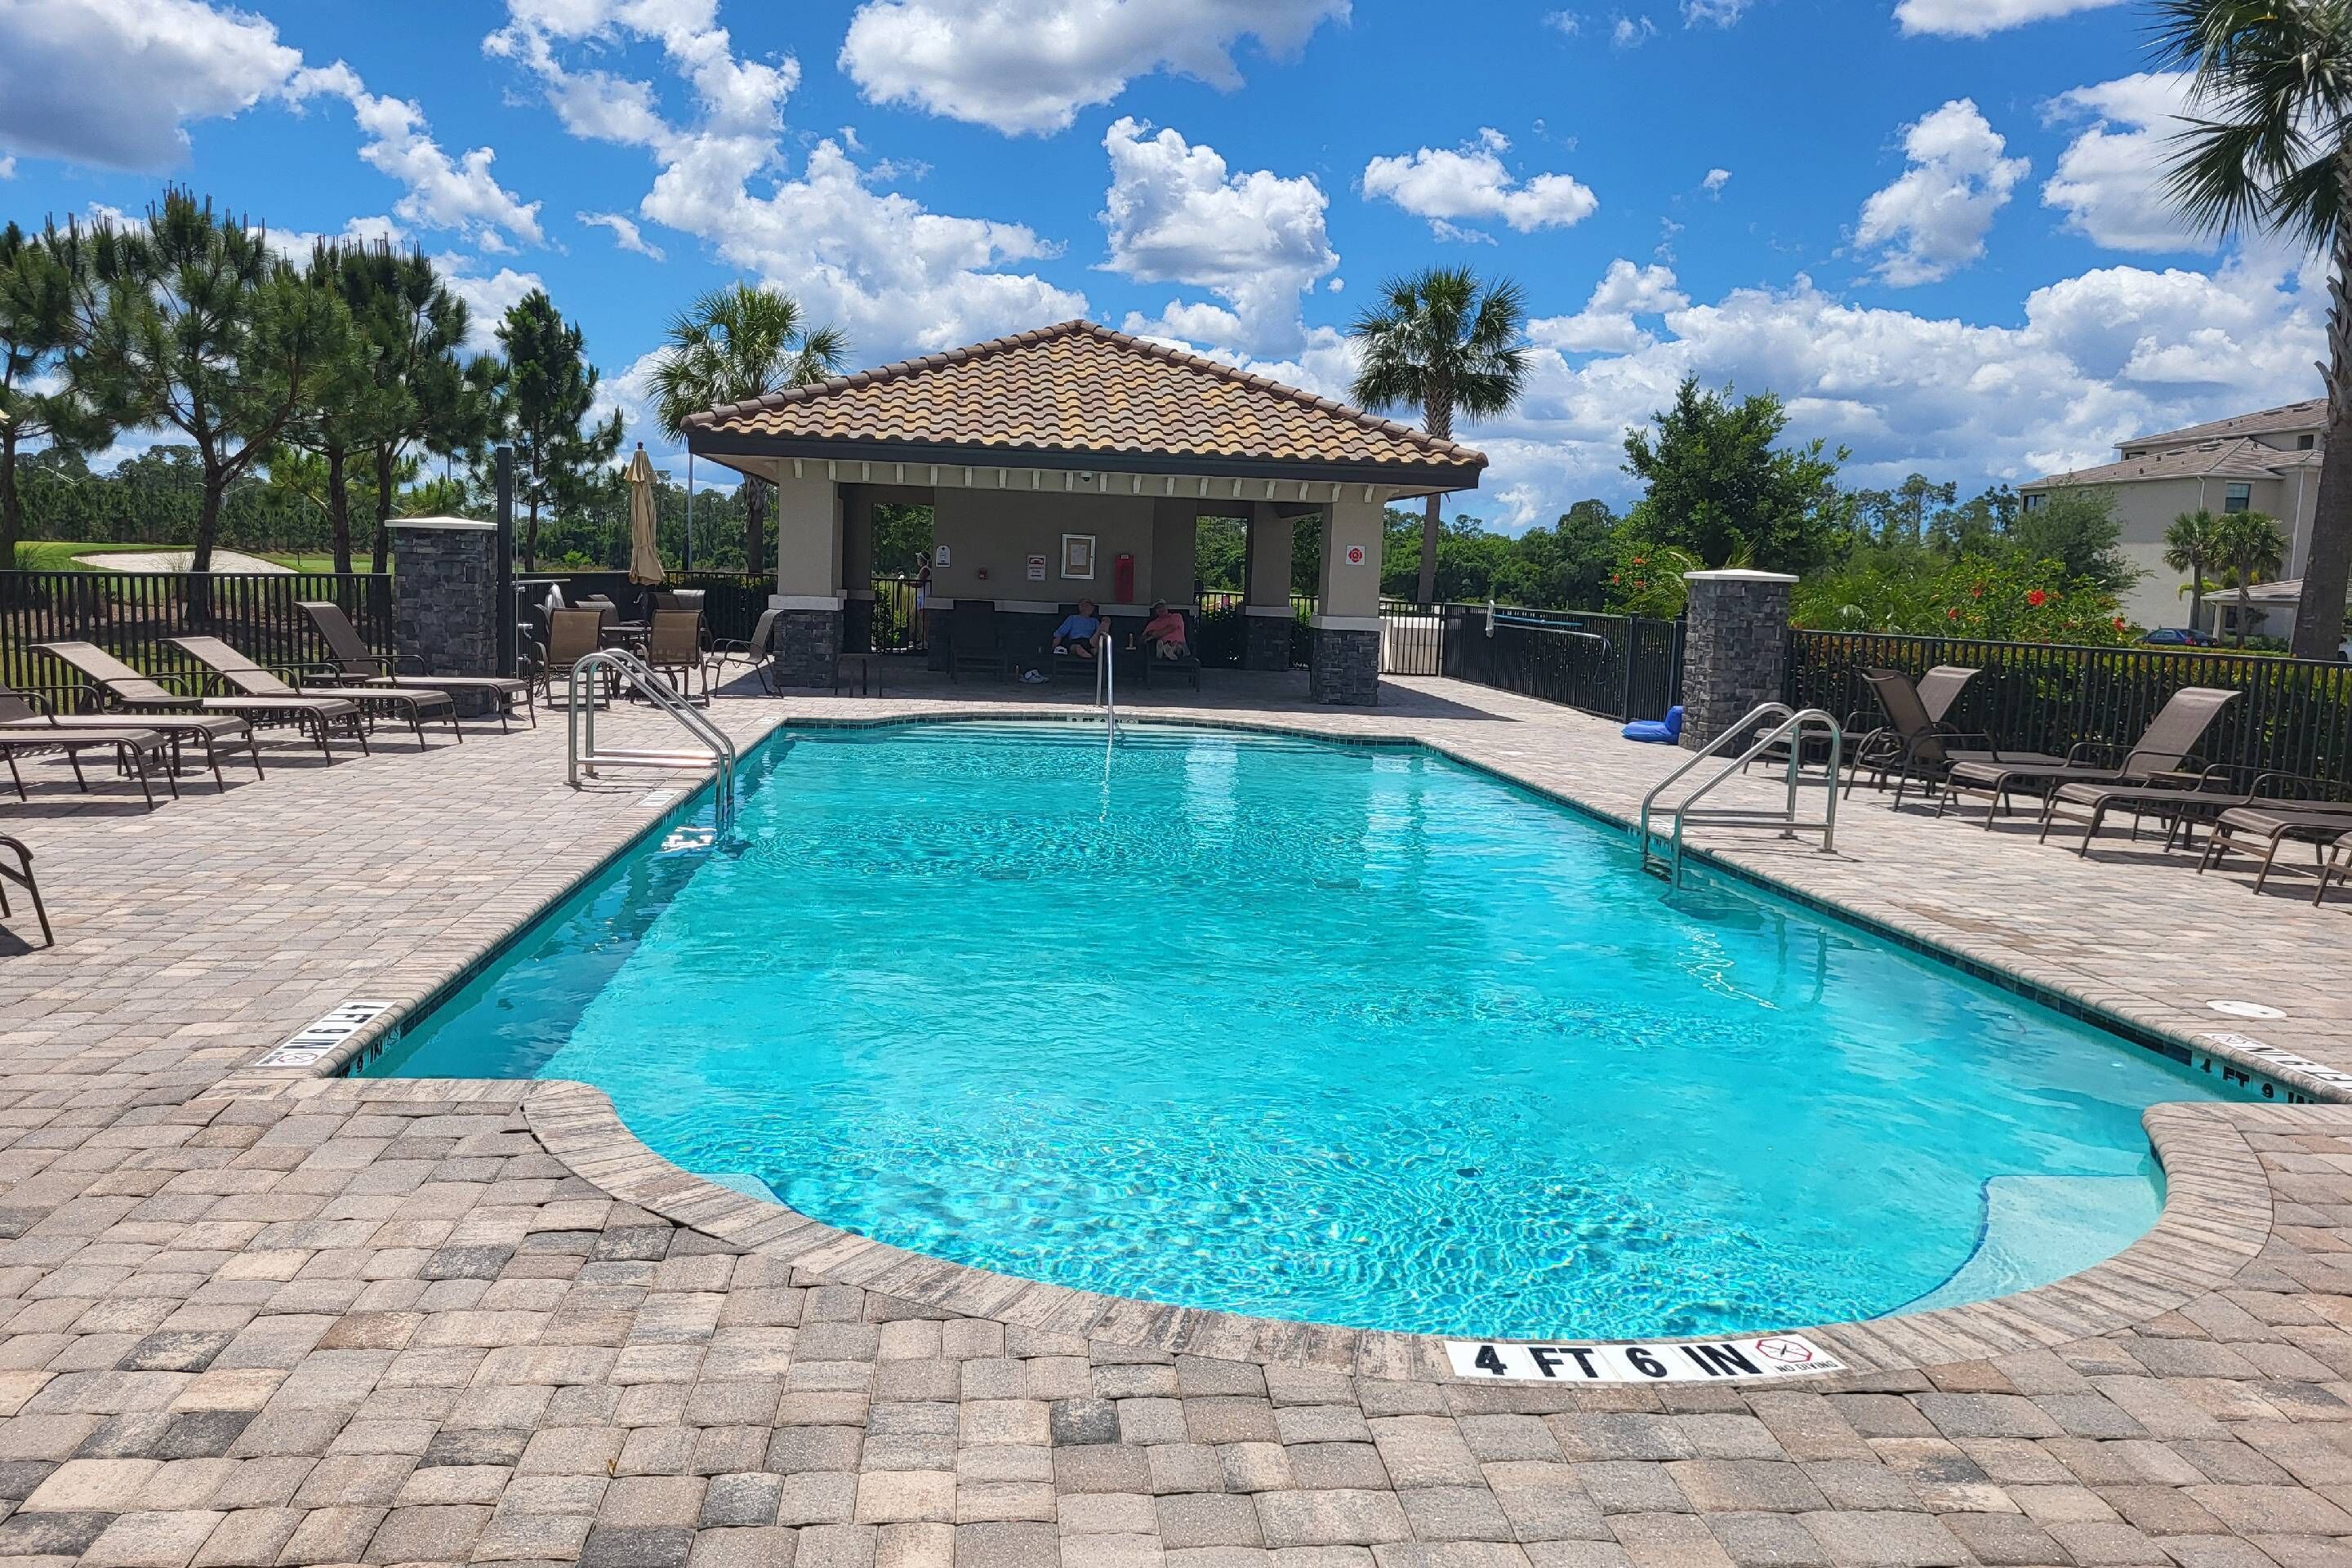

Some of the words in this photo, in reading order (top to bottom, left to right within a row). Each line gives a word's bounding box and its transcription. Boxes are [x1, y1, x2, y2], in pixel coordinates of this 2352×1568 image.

[323, 1013, 373, 1023] FT
[283, 1039, 341, 1049] IN
[370, 1040, 383, 1062] IN
[2222, 1065, 2250, 1088] FT
[2261, 1083, 2274, 1098] 9
[1474, 1344, 1508, 1375] 4
[1527, 1346, 1600, 1379] FT
[1629, 1347, 1668, 1379] 6
[1680, 1343, 1764, 1376] IN
[1774, 1365, 1796, 1373] NO
[1795, 1361, 1839, 1371] DIVING
